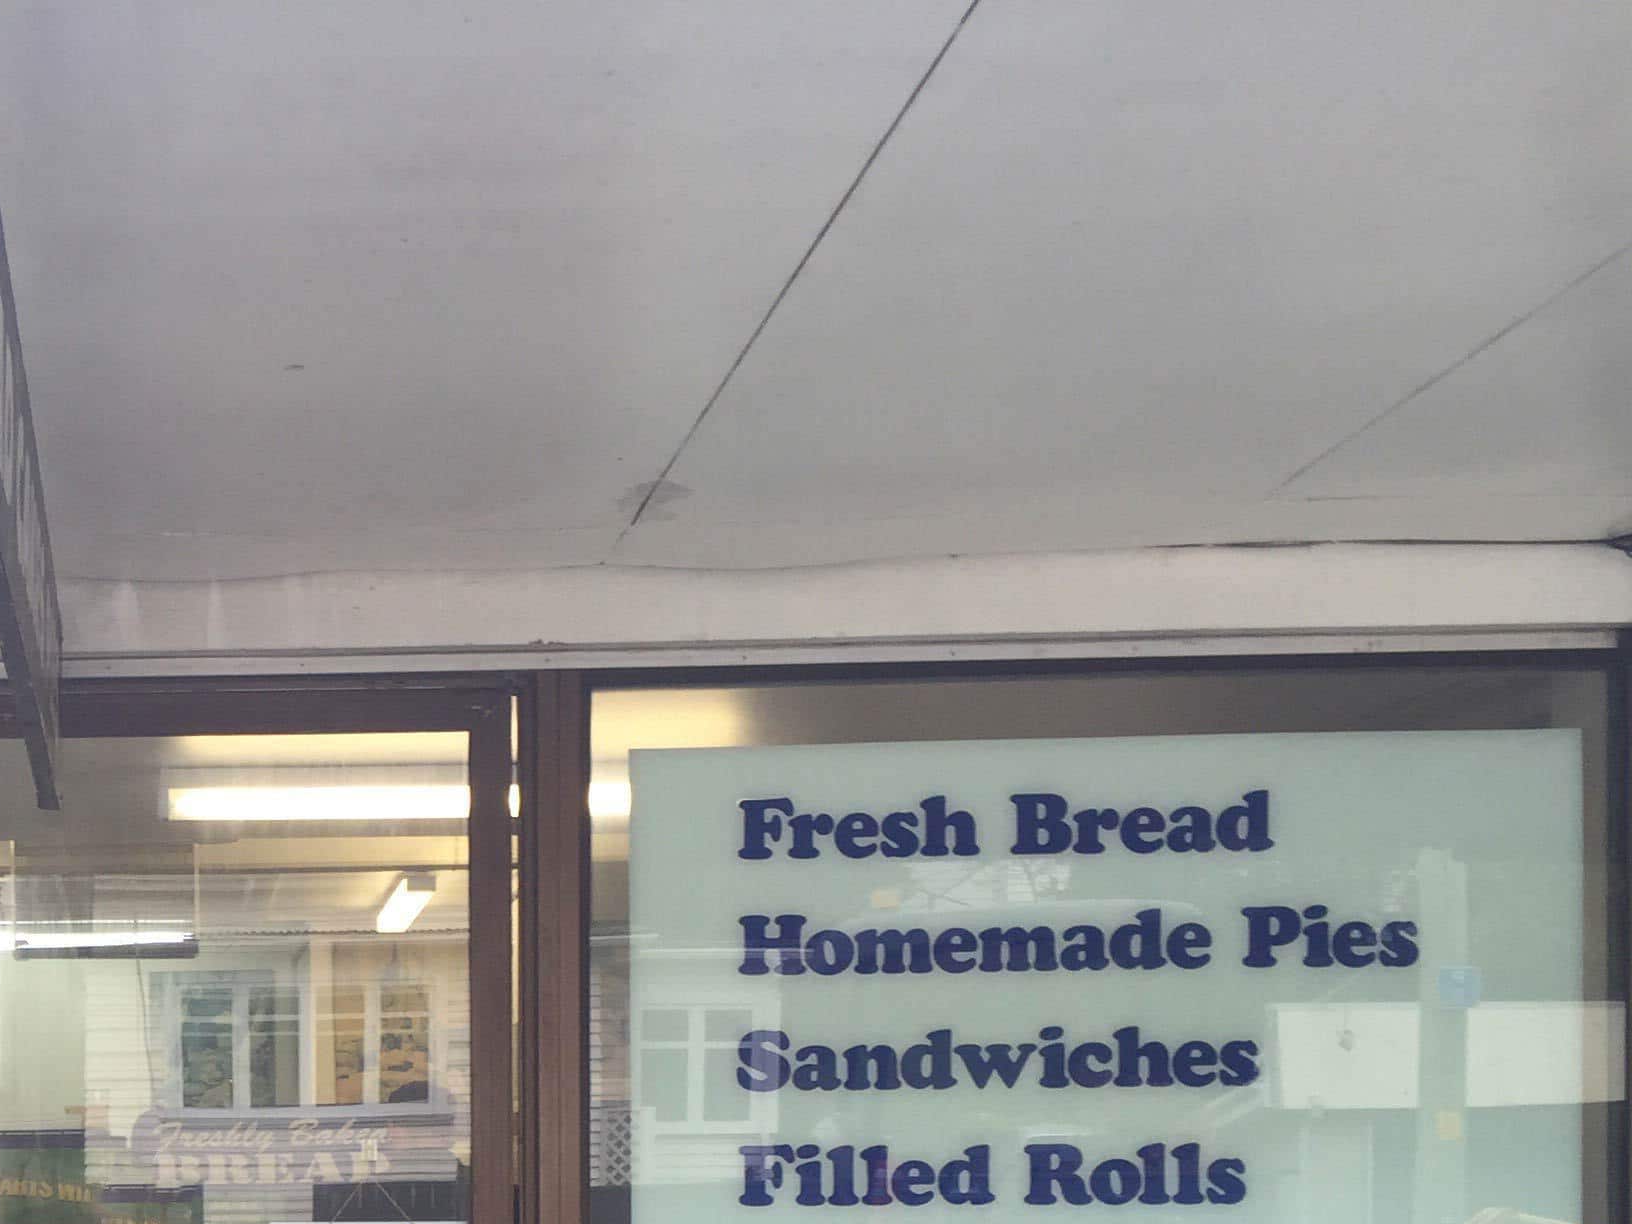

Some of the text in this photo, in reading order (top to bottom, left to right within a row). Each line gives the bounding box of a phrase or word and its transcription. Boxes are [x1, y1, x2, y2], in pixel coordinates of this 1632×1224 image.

[738, 790, 1274, 860] Fresh Bread
[738, 904, 1420, 975] Homemade Pies
[737, 1026, 1260, 1091] Sandwiches
[153, 1120, 273, 1153] Freshly
[738, 1143, 1248, 1206] Filled Rolls
